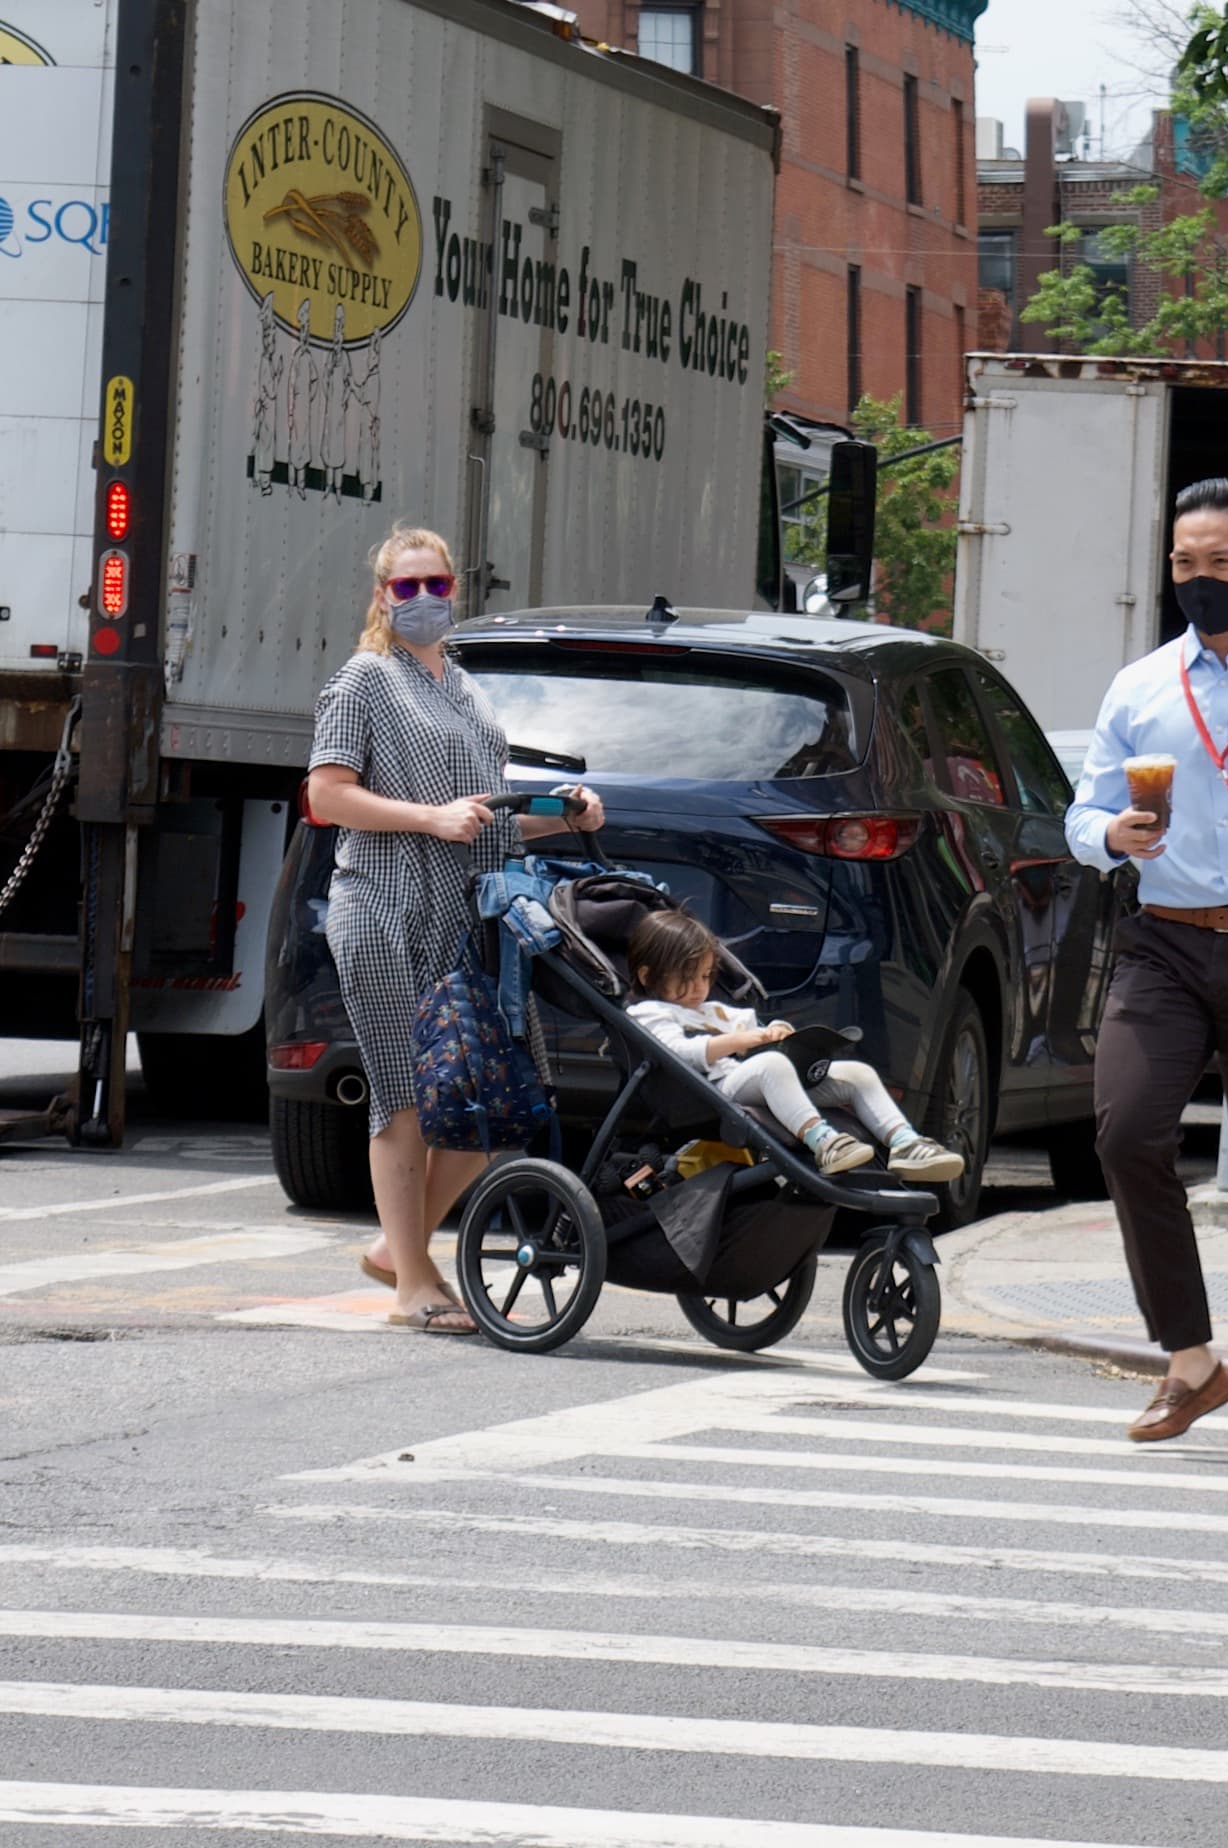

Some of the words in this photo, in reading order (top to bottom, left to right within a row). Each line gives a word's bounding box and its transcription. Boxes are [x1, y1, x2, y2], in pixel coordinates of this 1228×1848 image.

[238, 115, 409, 245] INTER-COUNTY
[251, 241, 323, 290] BAKERY
[327, 263, 392, 309] SUPPLY
[433, 196, 493, 310] Your
[499, 219, 570, 334] Home
[577, 246, 613, 344] for
[621, 258, 672, 363] True
[679, 277, 749, 385] Choice
[112, 387, 126, 455] MAXON
[530, 372, 665, 461] 800.696.1350
